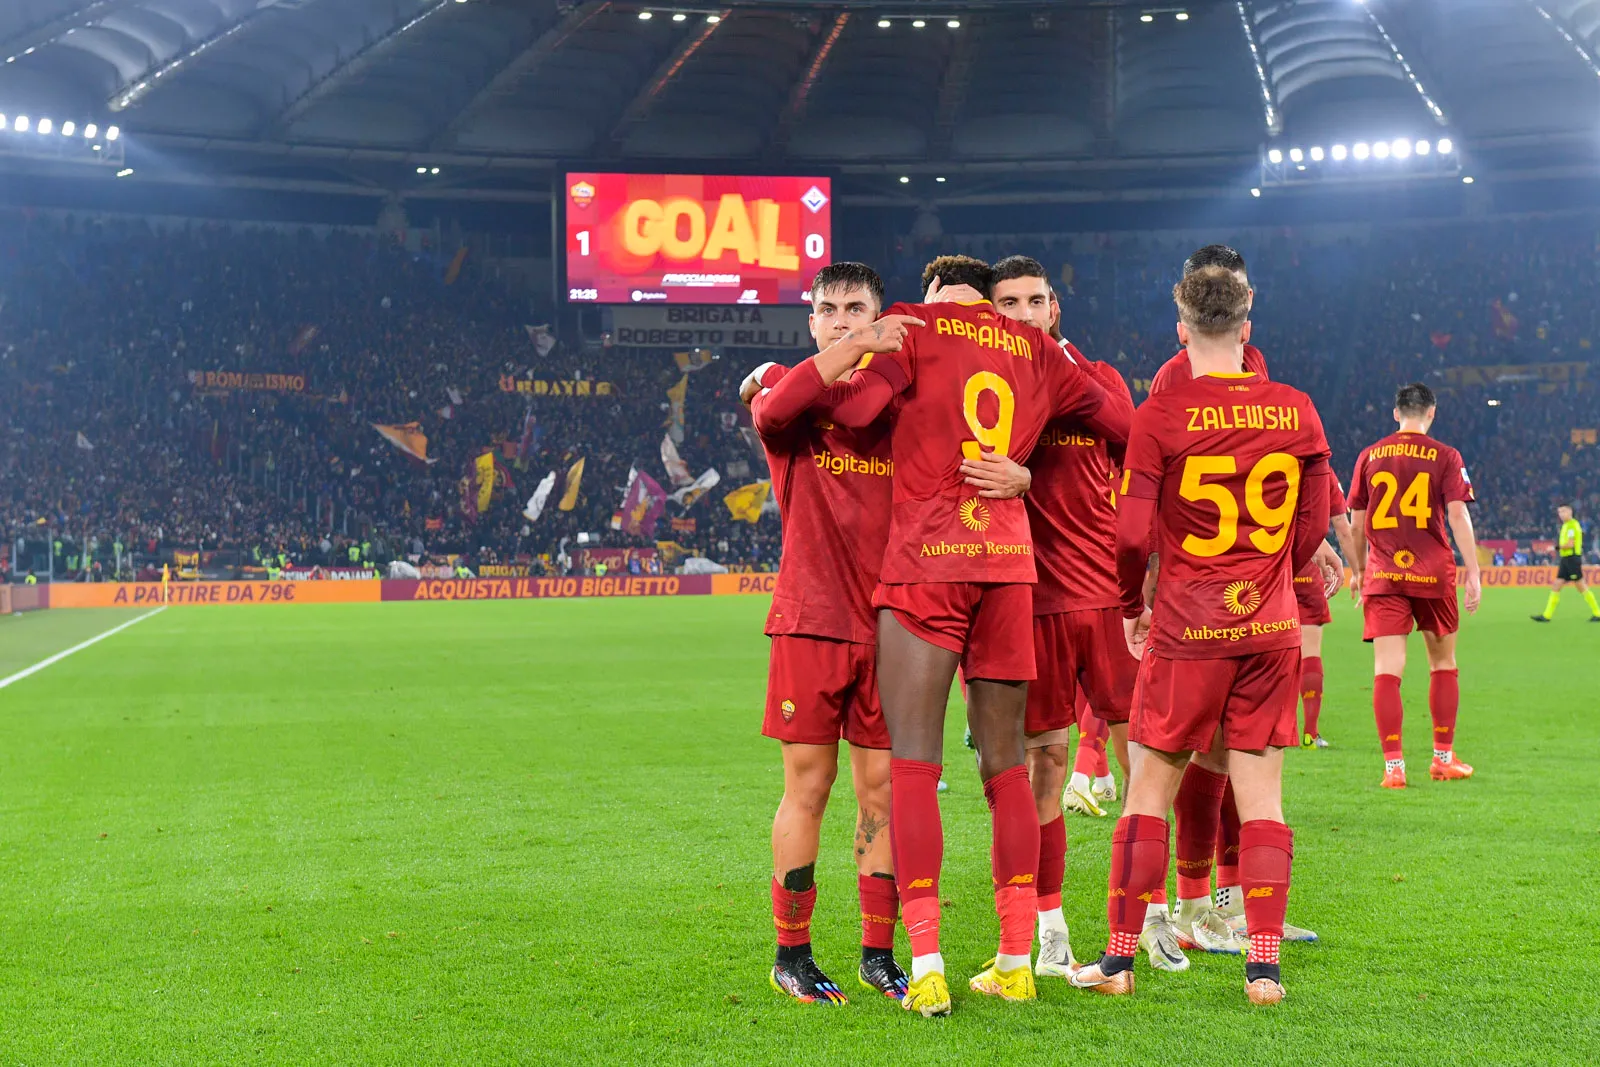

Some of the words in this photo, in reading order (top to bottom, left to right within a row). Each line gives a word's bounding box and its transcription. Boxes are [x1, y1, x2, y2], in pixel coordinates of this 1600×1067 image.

[575, 230, 590, 256] 1
[624, 194, 799, 271] GOAL
[805, 233, 825, 259] 0
[667, 308, 763, 323] BRIGATA
[617, 327, 724, 344] ROBERTO
[734, 330, 798, 346] RULLI
[936, 318, 1033, 361] ABRAHAM
[961, 371, 1014, 461] 9
[1186, 405, 1299, 431] ZALEWSKI
[1369, 444, 1438, 461] KUMBULLA
[1179, 453, 1300, 557] 59
[1370, 471, 1432, 530] 24
[919, 541, 983, 558] Auberge
[986, 541, 1031, 556] Resorts
[414, 579, 512, 599] ACQUISTA
[516, 580, 532, 597] IL
[537, 578, 577, 597] TUO
[581, 576, 680, 596] BIGLIETTO
[1405, 573, 1438, 584] Resorts
[114, 586, 128, 603] A
[134, 585, 221, 602] PARTIRE
[227, 584, 254, 600] DA
[259, 583, 296, 600] 79€
[1181, 626, 1247, 641] Auberge
